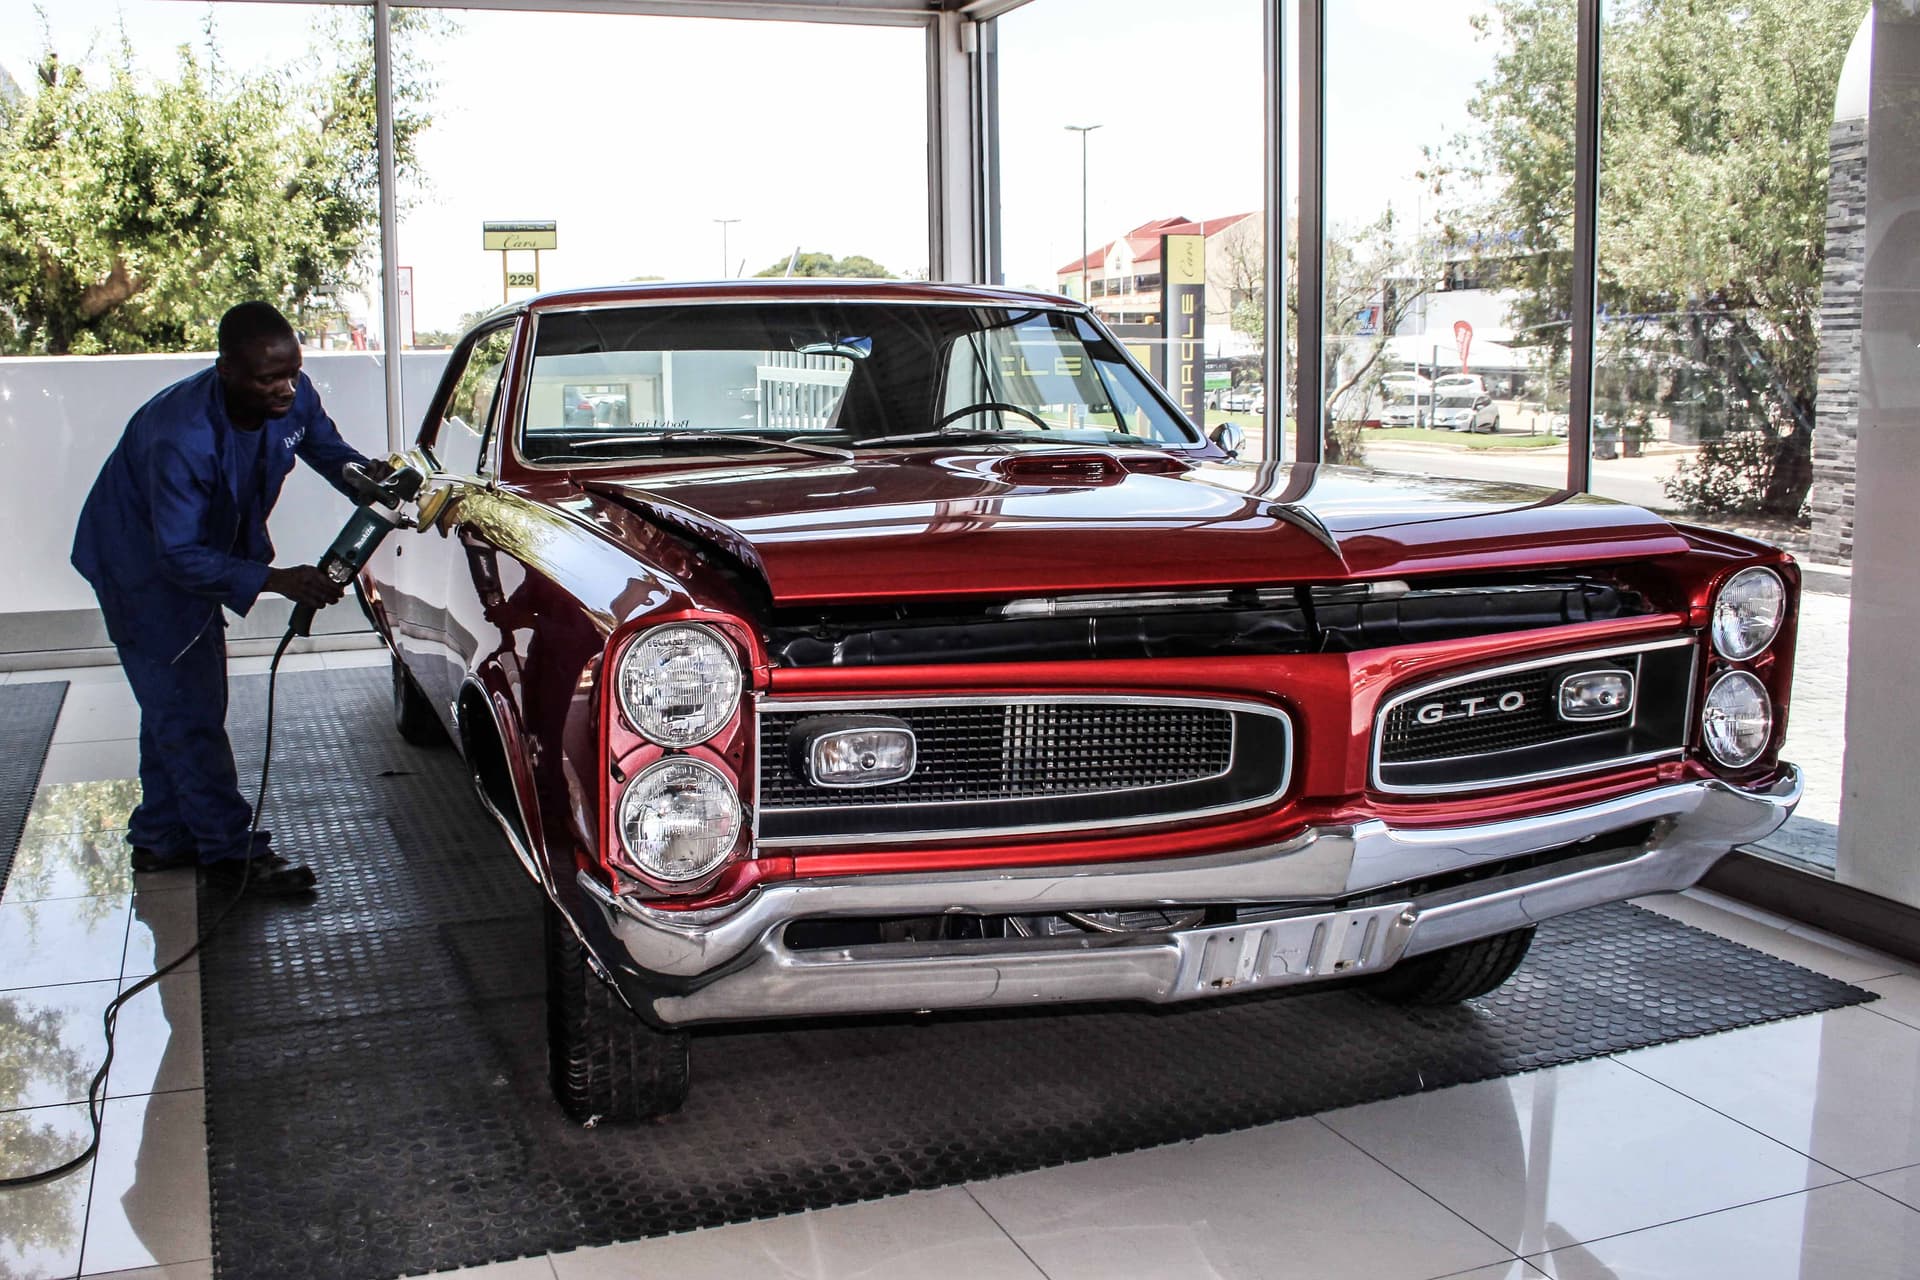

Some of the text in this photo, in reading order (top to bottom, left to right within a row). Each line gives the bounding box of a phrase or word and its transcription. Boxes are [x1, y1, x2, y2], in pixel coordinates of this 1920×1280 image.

[504, 235, 536, 248] Cars
[509, 274, 534, 286] 229
[1417, 691, 1525, 725] GTO
